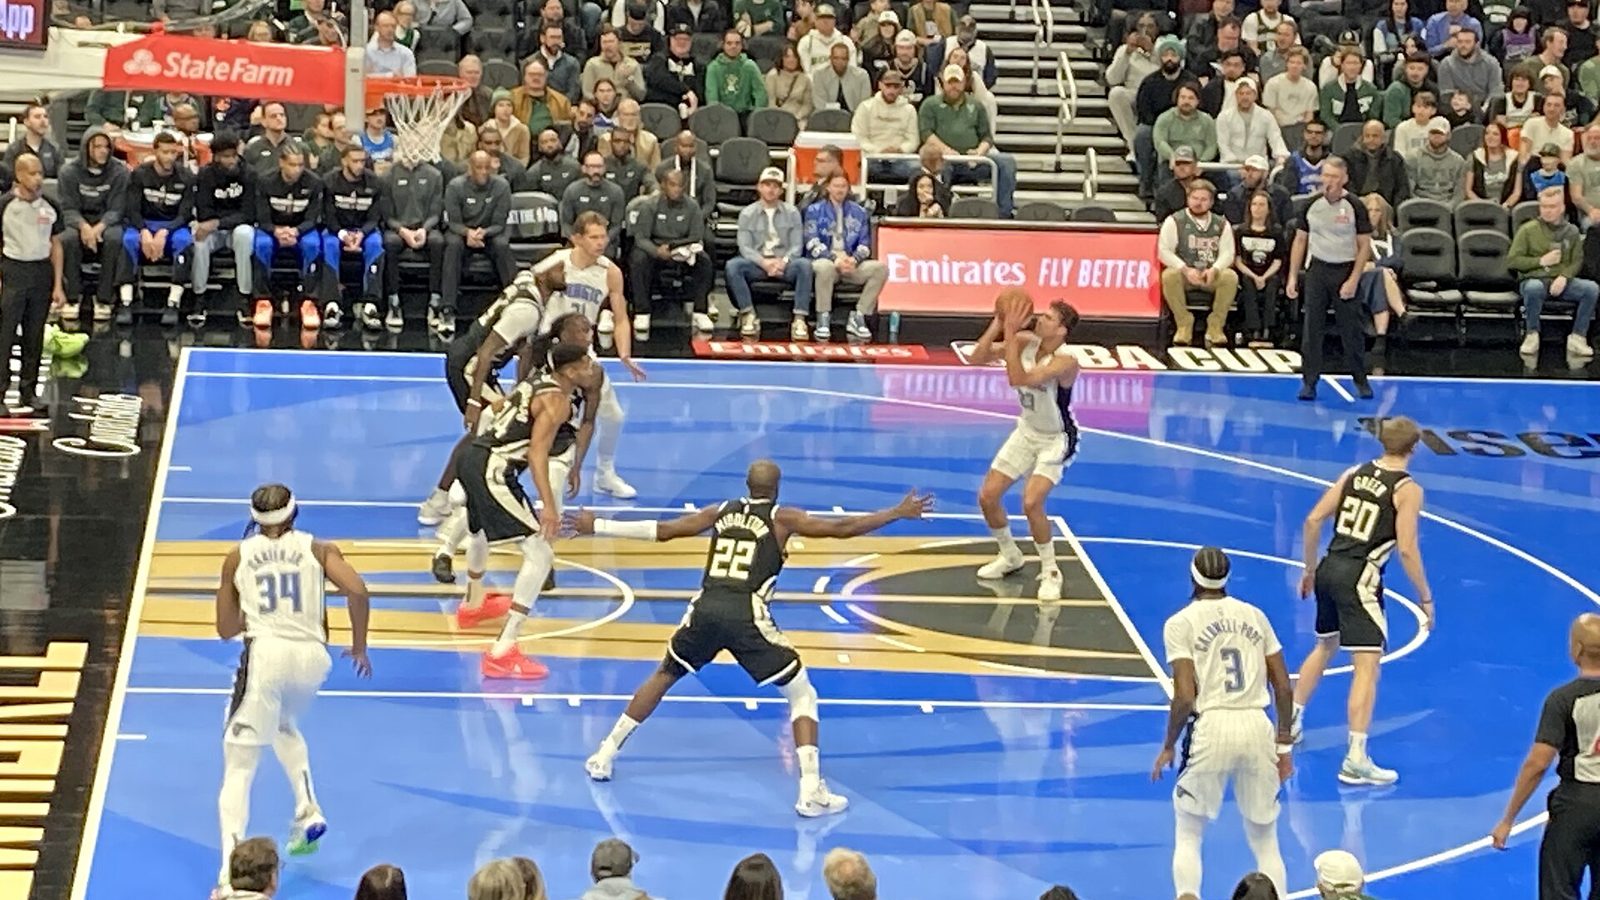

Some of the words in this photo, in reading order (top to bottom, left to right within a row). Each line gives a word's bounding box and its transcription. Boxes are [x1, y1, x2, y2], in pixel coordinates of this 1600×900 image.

[886, 253, 1027, 286] Emirates
[1038, 257, 1073, 288] FLY
[1077, 258, 1151, 289] BETTER
[708, 341, 914, 358] Emirates
[1053, 344, 1168, 370] BA
[1167, 347, 1303, 374] CUP
[1352, 475, 1388, 498] GREEN
[1336, 495, 1380, 542] 20
[708, 537, 756, 580] 22
[254, 571, 303, 614] 34
[1219, 646, 1247, 693] 3
